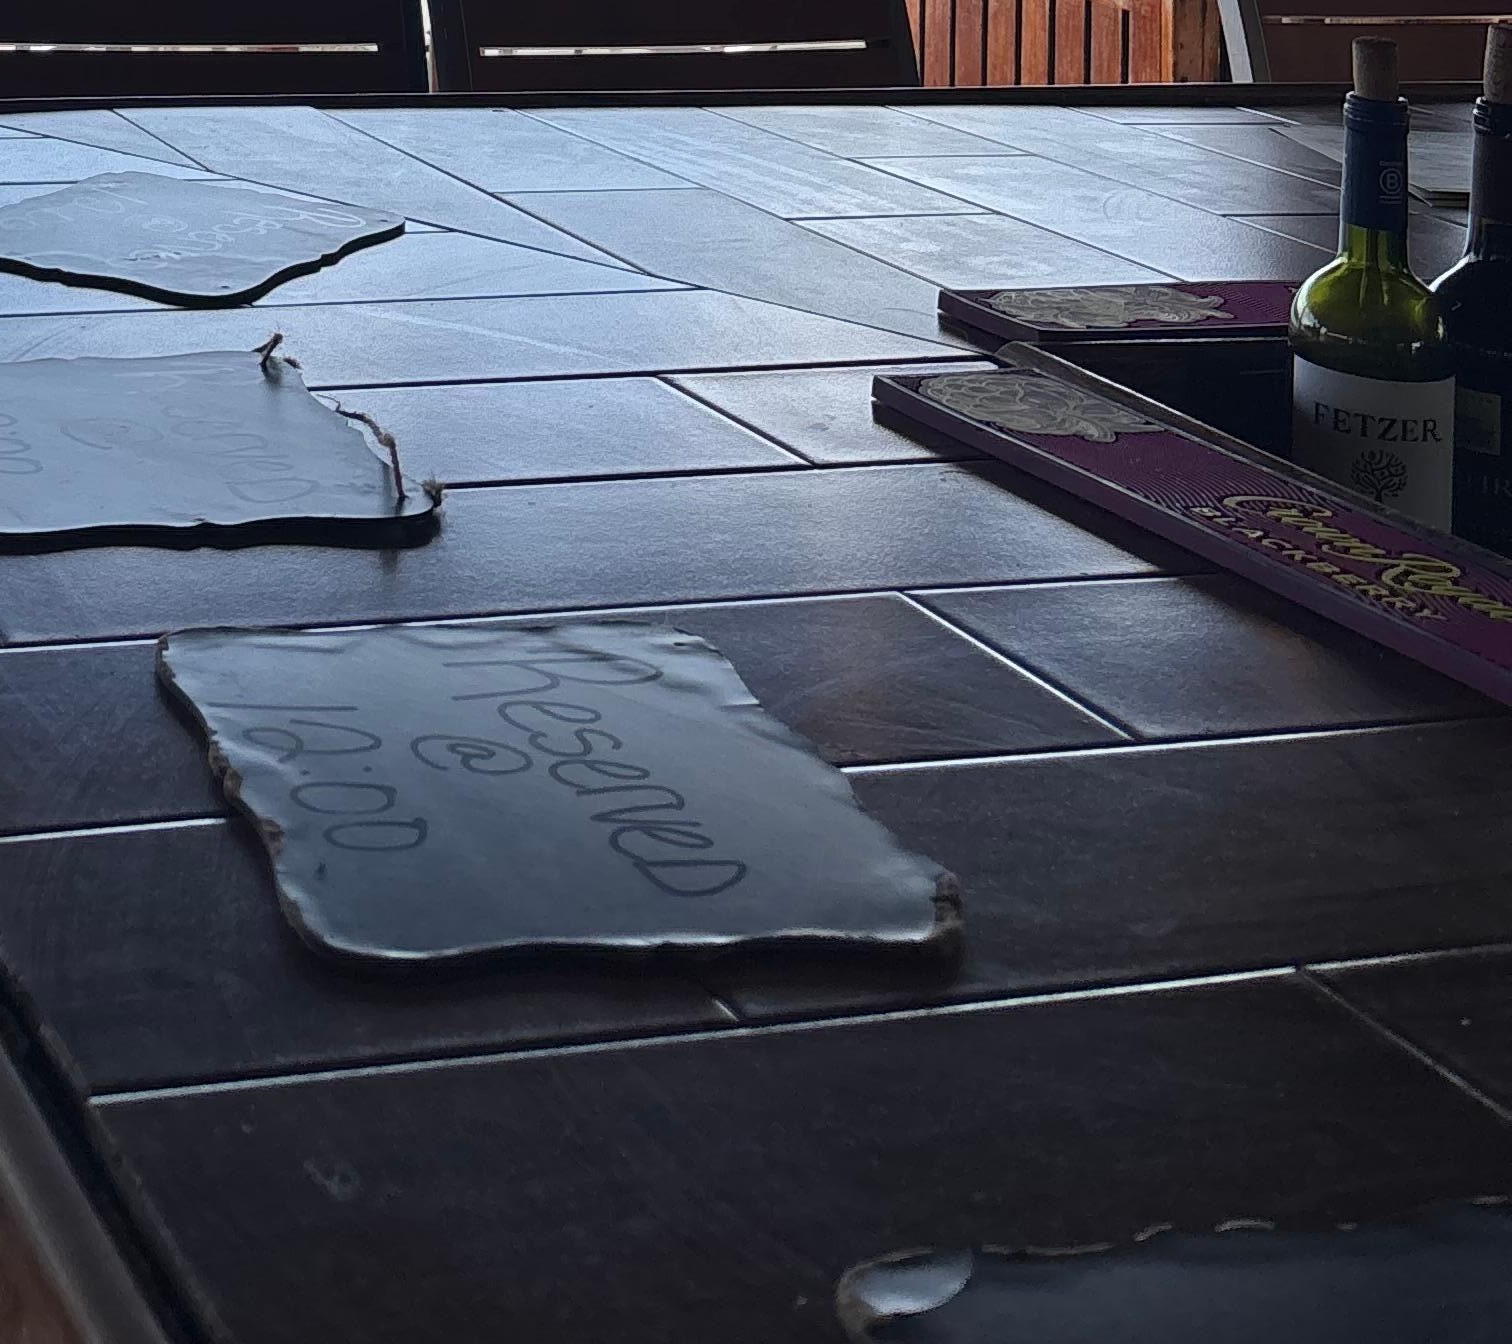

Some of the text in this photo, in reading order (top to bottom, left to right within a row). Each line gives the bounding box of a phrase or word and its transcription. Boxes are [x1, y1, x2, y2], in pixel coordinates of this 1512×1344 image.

[1314, 401, 1444, 442] FETZER
[1191, 506, 1449, 621] BLACKBERRY
[205, 702, 430, 852] 12:00
[410, 733, 535, 776] @
